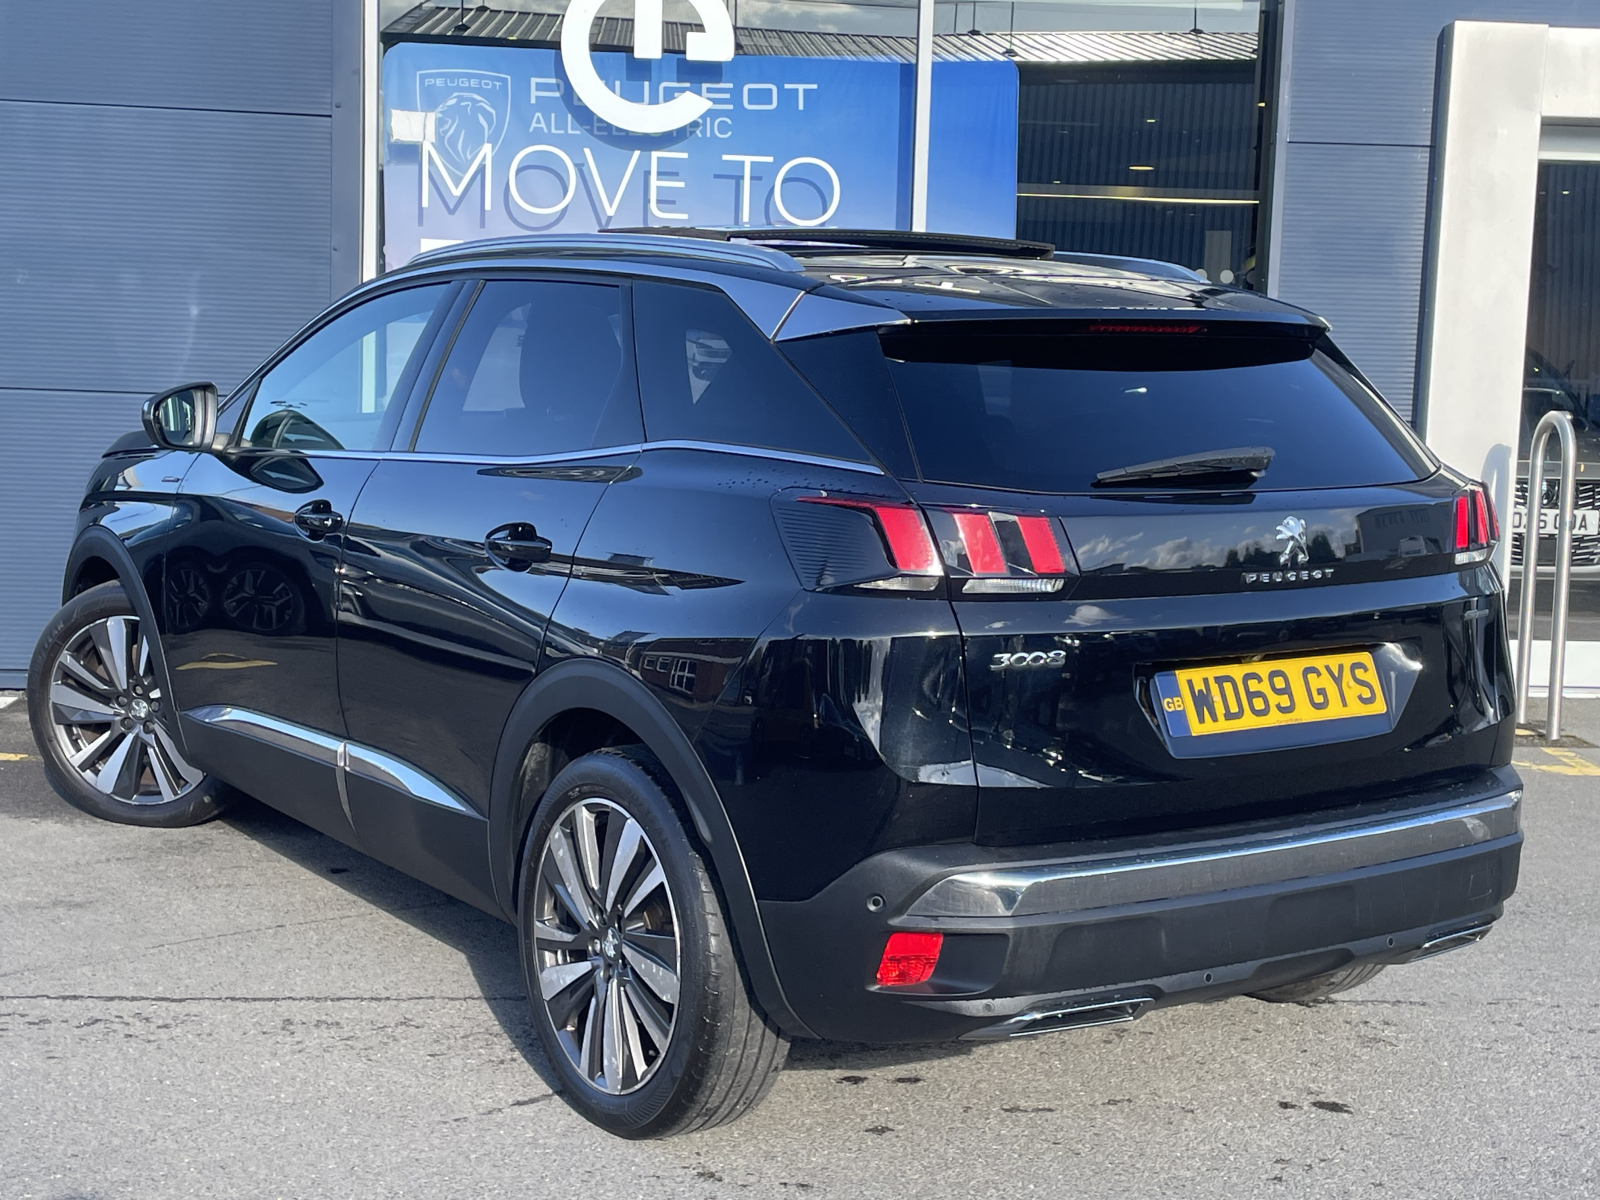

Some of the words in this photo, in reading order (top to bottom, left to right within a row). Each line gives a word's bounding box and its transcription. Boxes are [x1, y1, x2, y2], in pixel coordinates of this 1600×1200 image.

[424, 78, 503, 90] PEUGEOT
[529, 112, 733, 138] ALL-ELRIC
[421, 141, 689, 220] MOVE
[721, 154, 841, 227] TO
[1242, 569, 1335, 584] PEUGEOT
[989, 650, 1067, 671] 3008
[1186, 669, 1296, 724] WD69
[1302, 661, 1377, 710] GYS
[1163, 697, 1184, 712] GB
